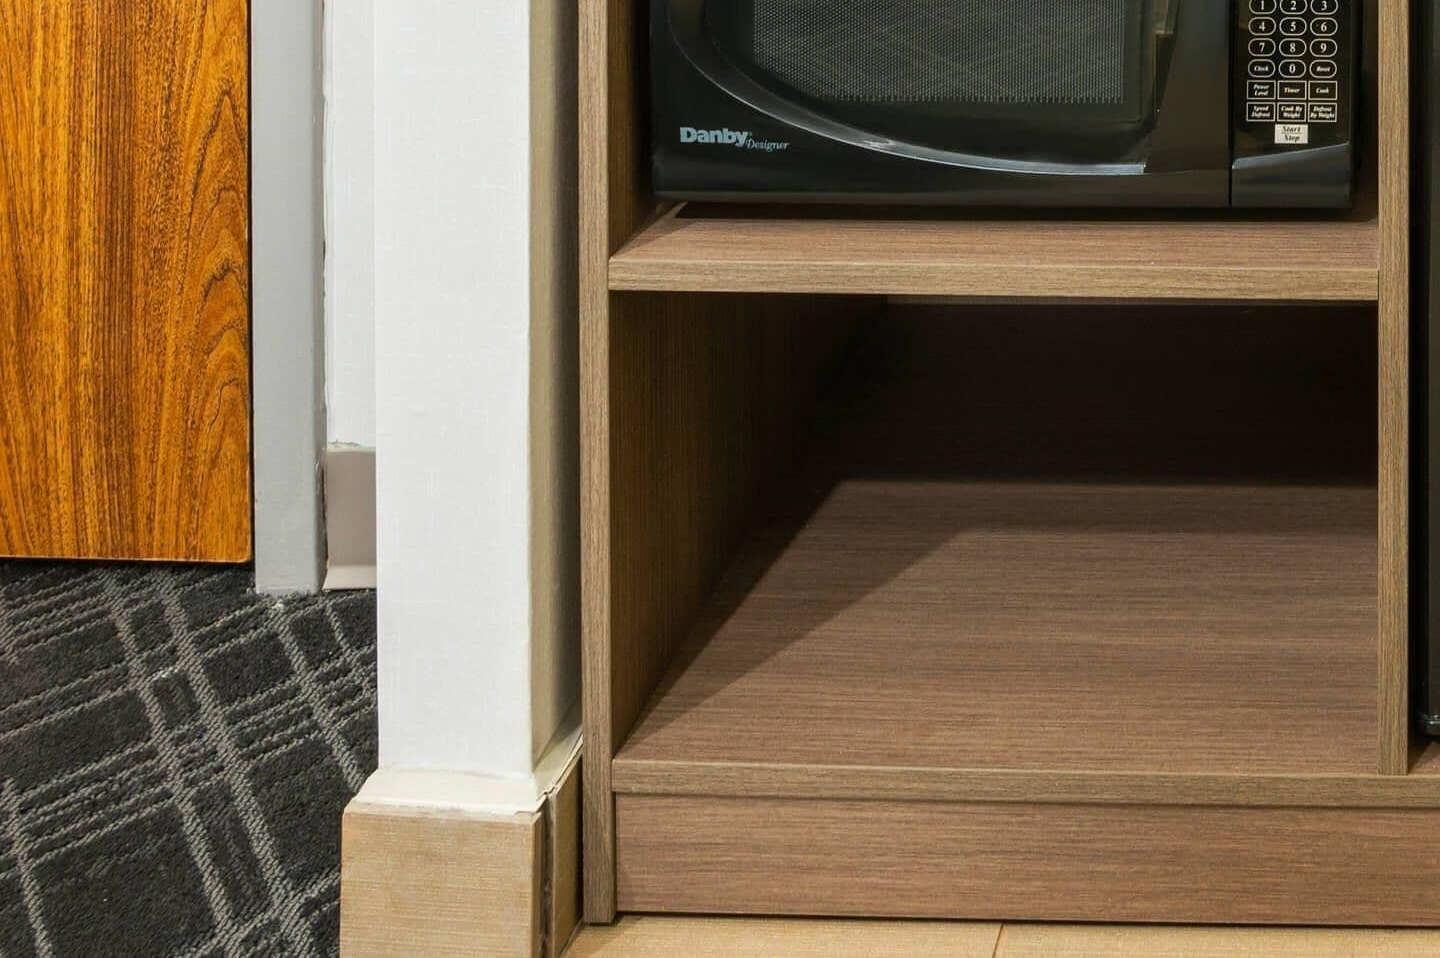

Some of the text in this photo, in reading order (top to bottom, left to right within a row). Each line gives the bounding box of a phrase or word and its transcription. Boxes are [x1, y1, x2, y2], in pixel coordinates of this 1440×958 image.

[1290, 0, 1297, 11] 2
[1321, 0, 1328, 11] 3
[1259, 21, 1266, 32] 4
[1290, 21, 1297, 32] 5
[1320, 21, 1327, 32] 6
[1259, 42, 1265, 52] 7
[1289, 42, 1296, 53] 8
[1320, 42, 1327, 53] 9
[1289, 64, 1296, 74] 0
[680, 126, 790, 152] Danby Designer
